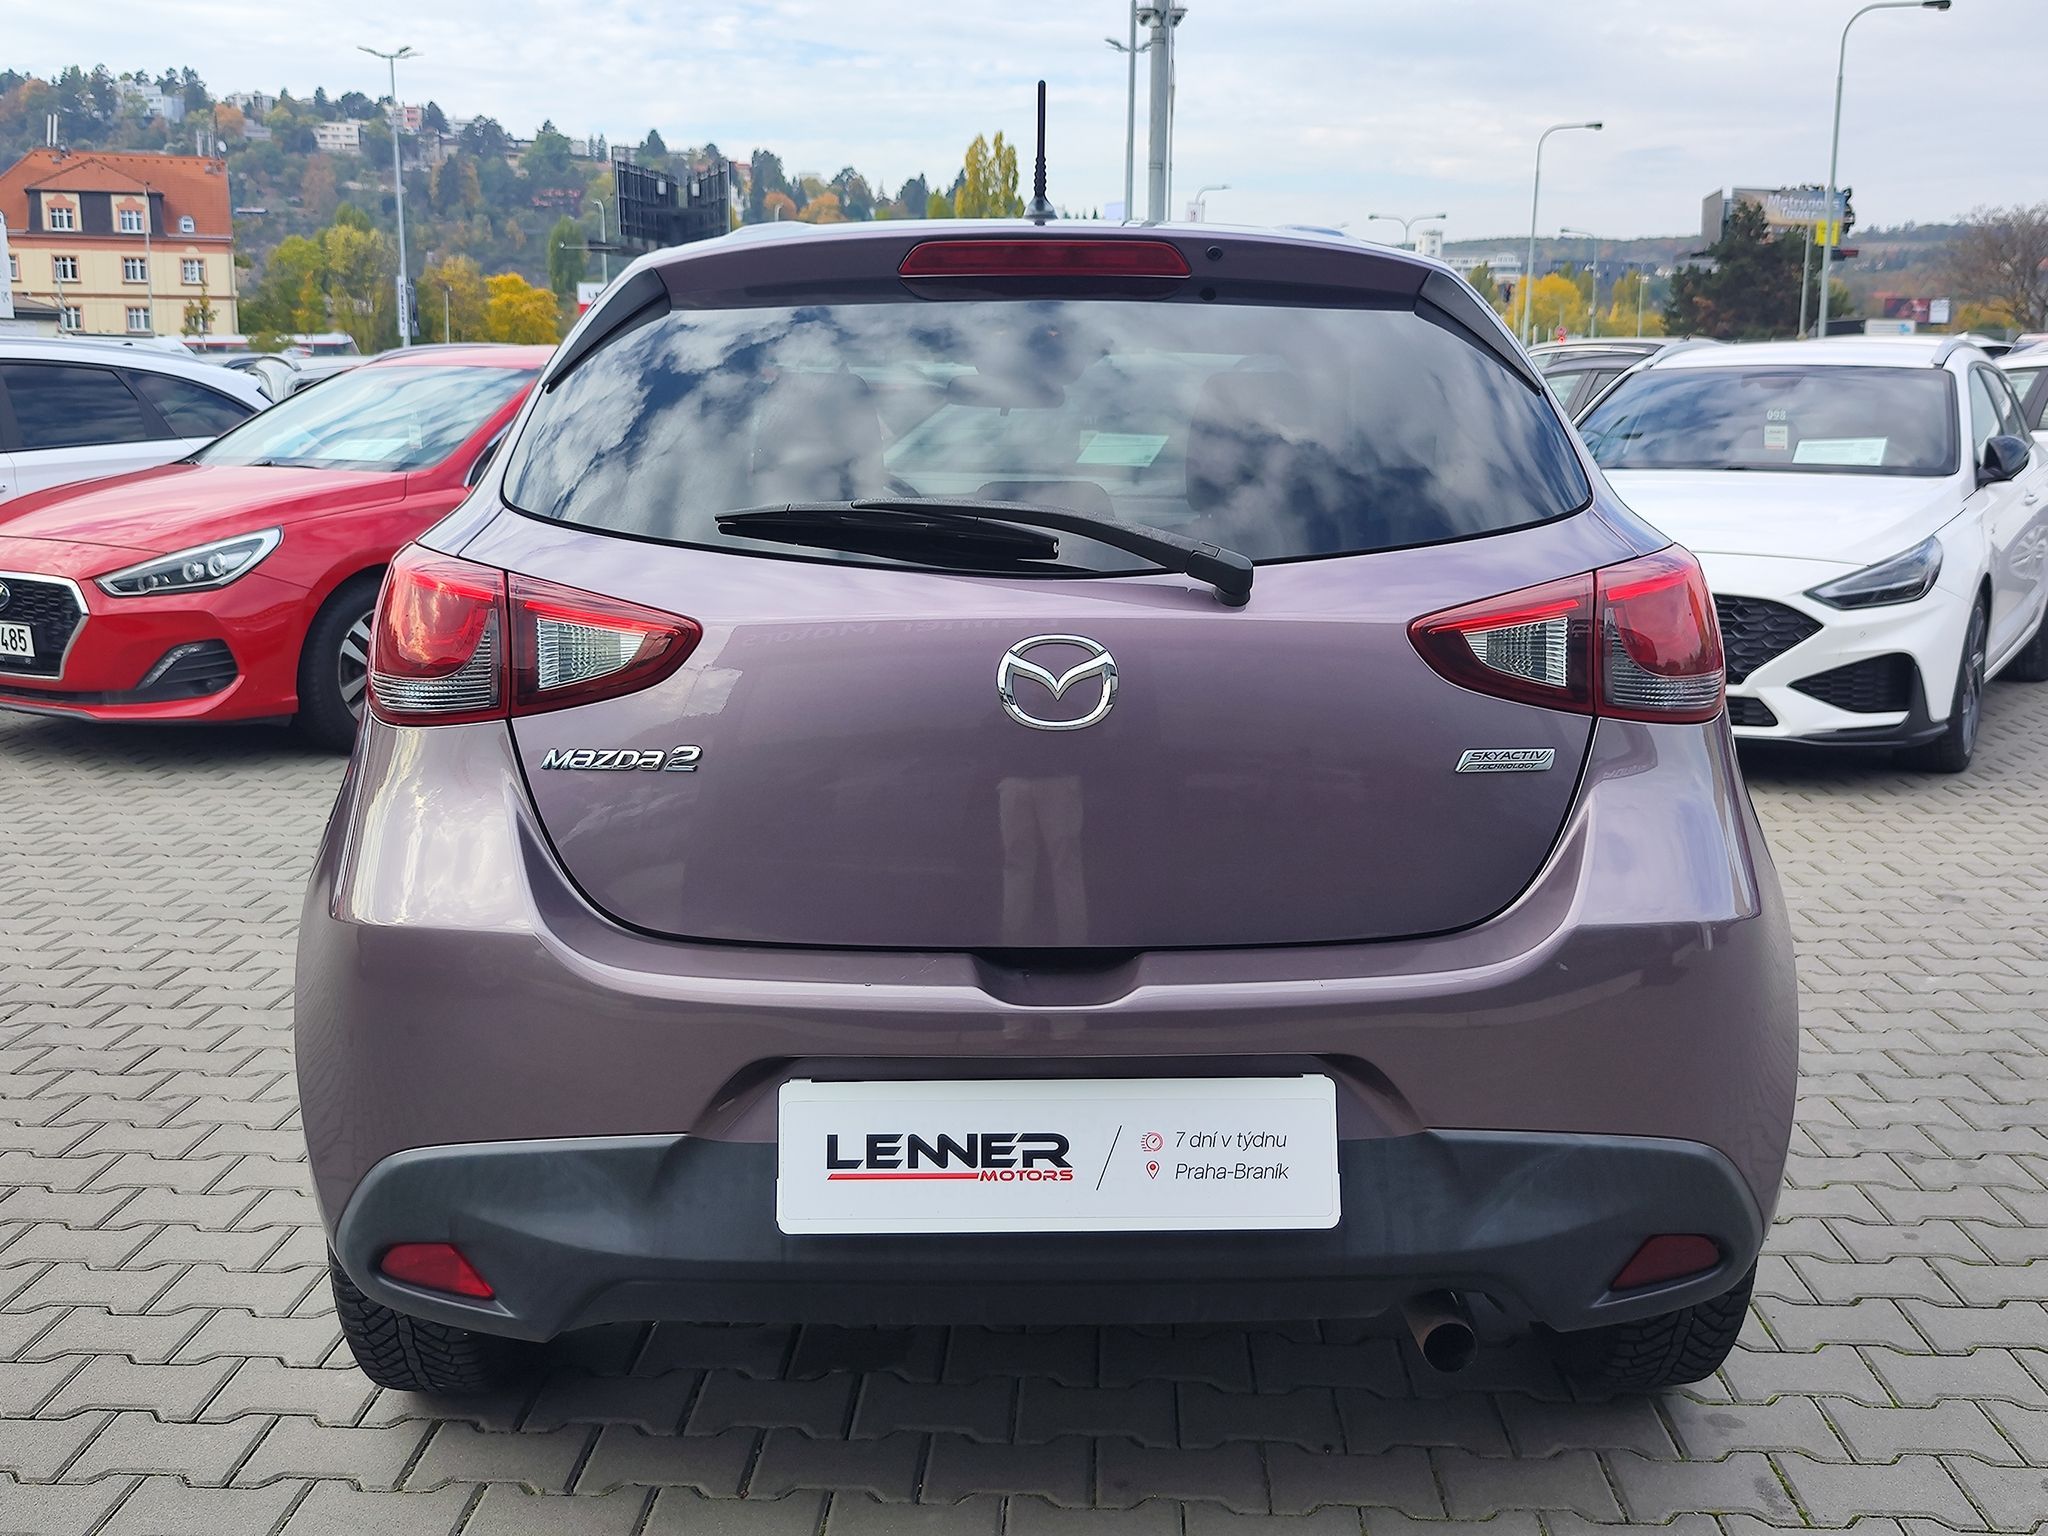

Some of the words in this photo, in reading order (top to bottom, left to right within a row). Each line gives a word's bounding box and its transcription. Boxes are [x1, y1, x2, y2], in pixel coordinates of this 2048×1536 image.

[1766, 192, 1841, 209] Metropos
[1, 626, 27, 652] 485
[1470, 750, 1547, 761] SKYACTIV
[1476, 762, 1538, 770] TECHNOLOGY
[1175, 1131, 1186, 1148] 7
[1189, 1130, 1218, 1148] dní
[1221, 1134, 1232, 1148] v
[1237, 1130, 1287, 1152] týdnu
[827, 1133, 1073, 1169] LENNER
[980, 1169, 1073, 1181] MOTORS
[1175, 1162, 1290, 1180] Praha-Braník
